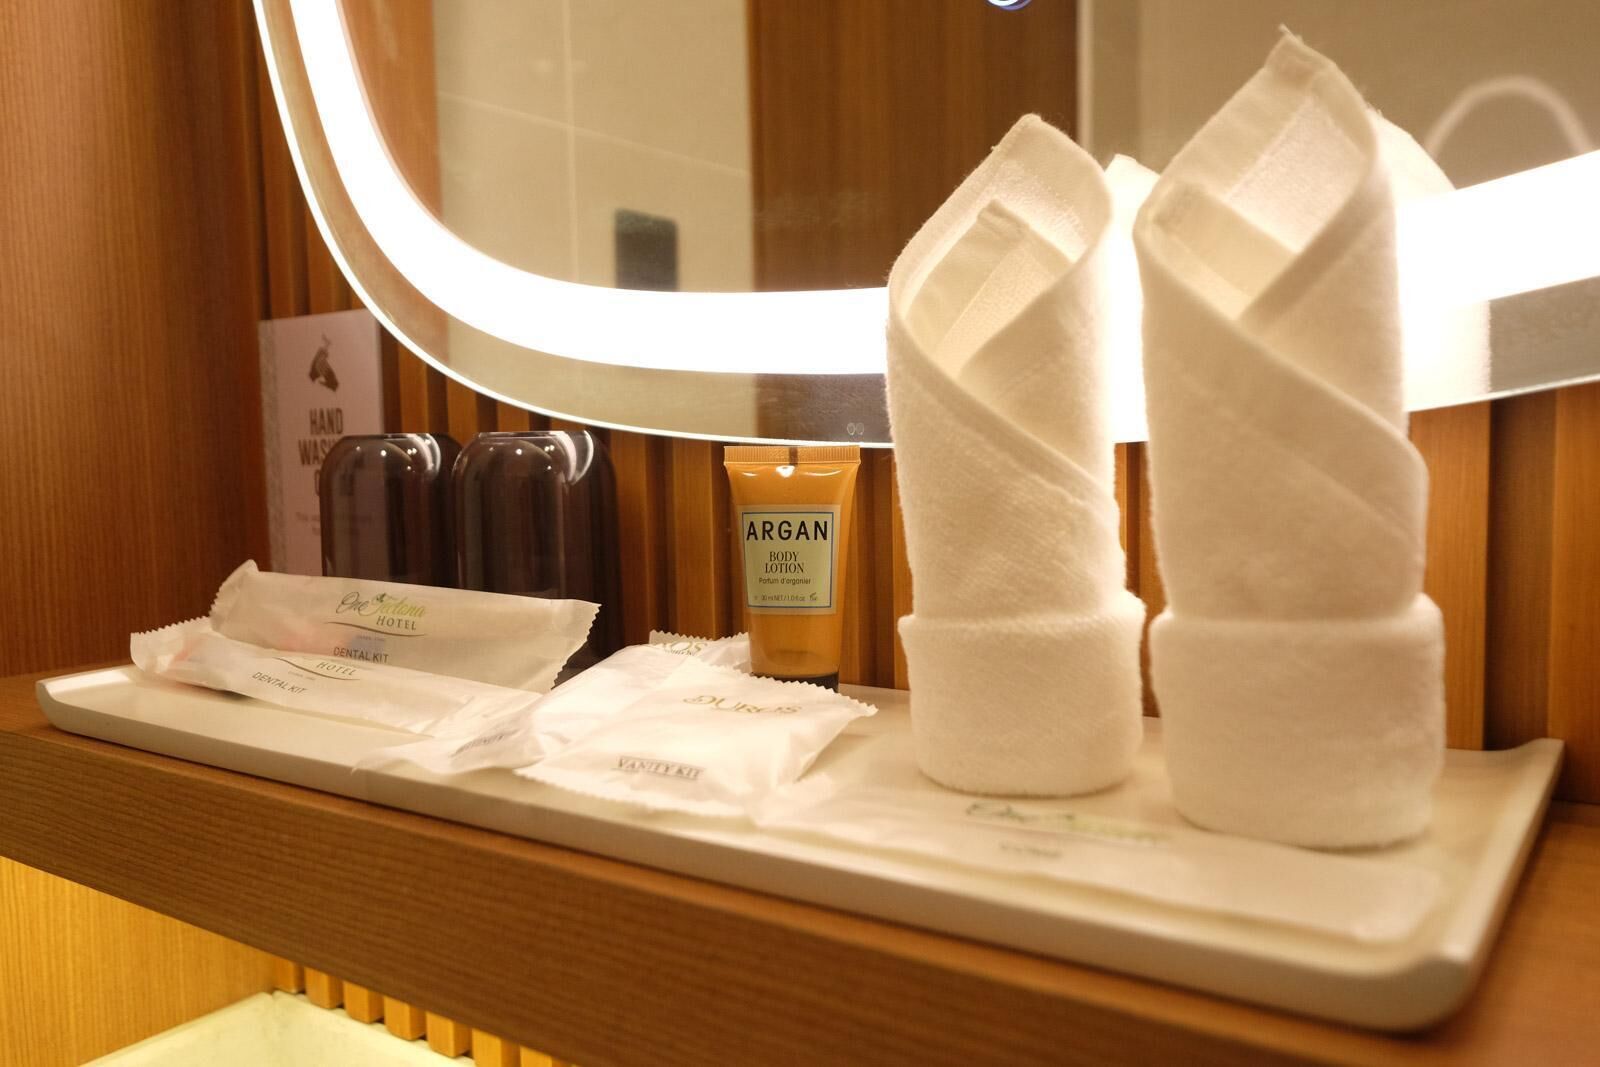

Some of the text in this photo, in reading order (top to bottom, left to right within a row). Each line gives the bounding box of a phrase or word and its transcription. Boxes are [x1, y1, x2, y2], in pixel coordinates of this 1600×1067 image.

[309, 407, 344, 435] HAND
[746, 520, 828, 541] ARGAN
[769, 551, 800, 562] BODY
[765, 563, 805, 574] LOTION
[376, 615, 417, 631] HOTEL
[333, 646, 390, 664] DENTAL KIT
[315, 661, 357, 676] HOTEL
[252, 671, 289, 690] DENTAL
[288, 685, 309, 695] KIT
